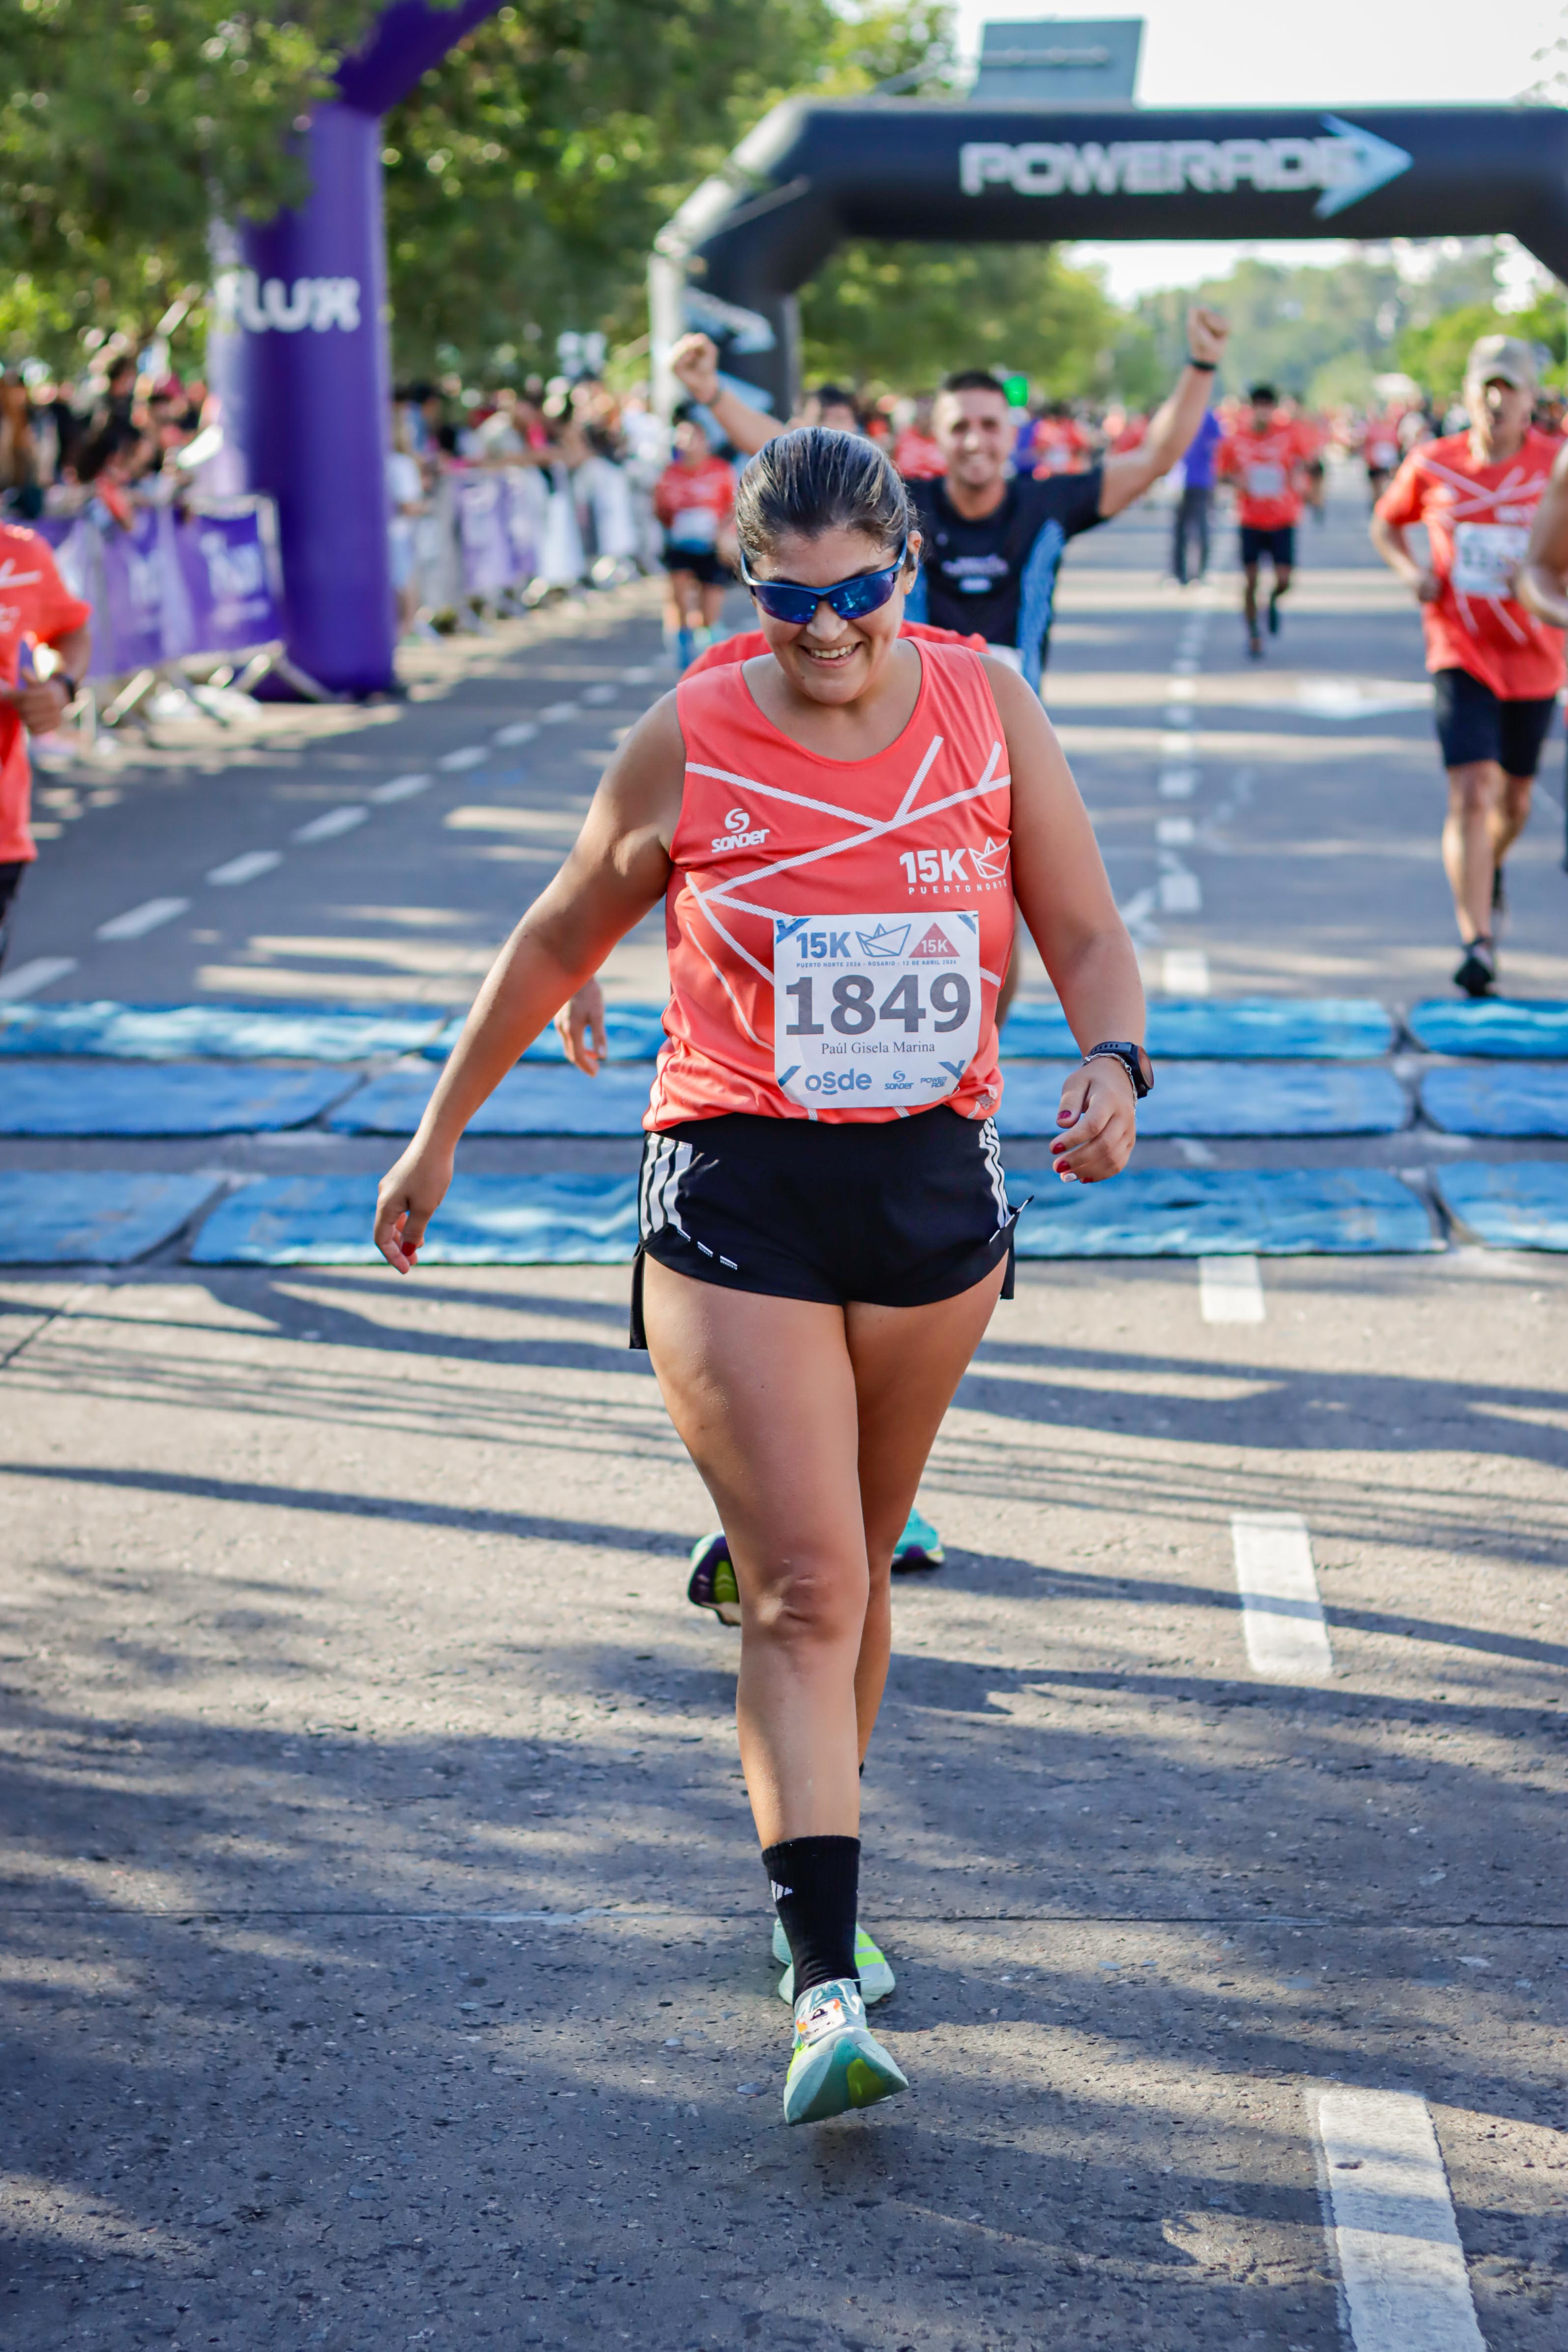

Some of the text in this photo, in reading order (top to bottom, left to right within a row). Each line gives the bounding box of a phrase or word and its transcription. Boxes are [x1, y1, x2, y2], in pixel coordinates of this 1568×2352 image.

[899, 849, 969, 883] 15K
[908, 879, 1007, 895] PUERTO NORTE
[796, 932, 852, 958] 15K
[921, 939, 948, 953] 15K
[786, 972, 971, 1035] 1849
[821, 1041, 935, 1054] Paúl Gisela Marina
[805, 1068, 872, 1092] osde
